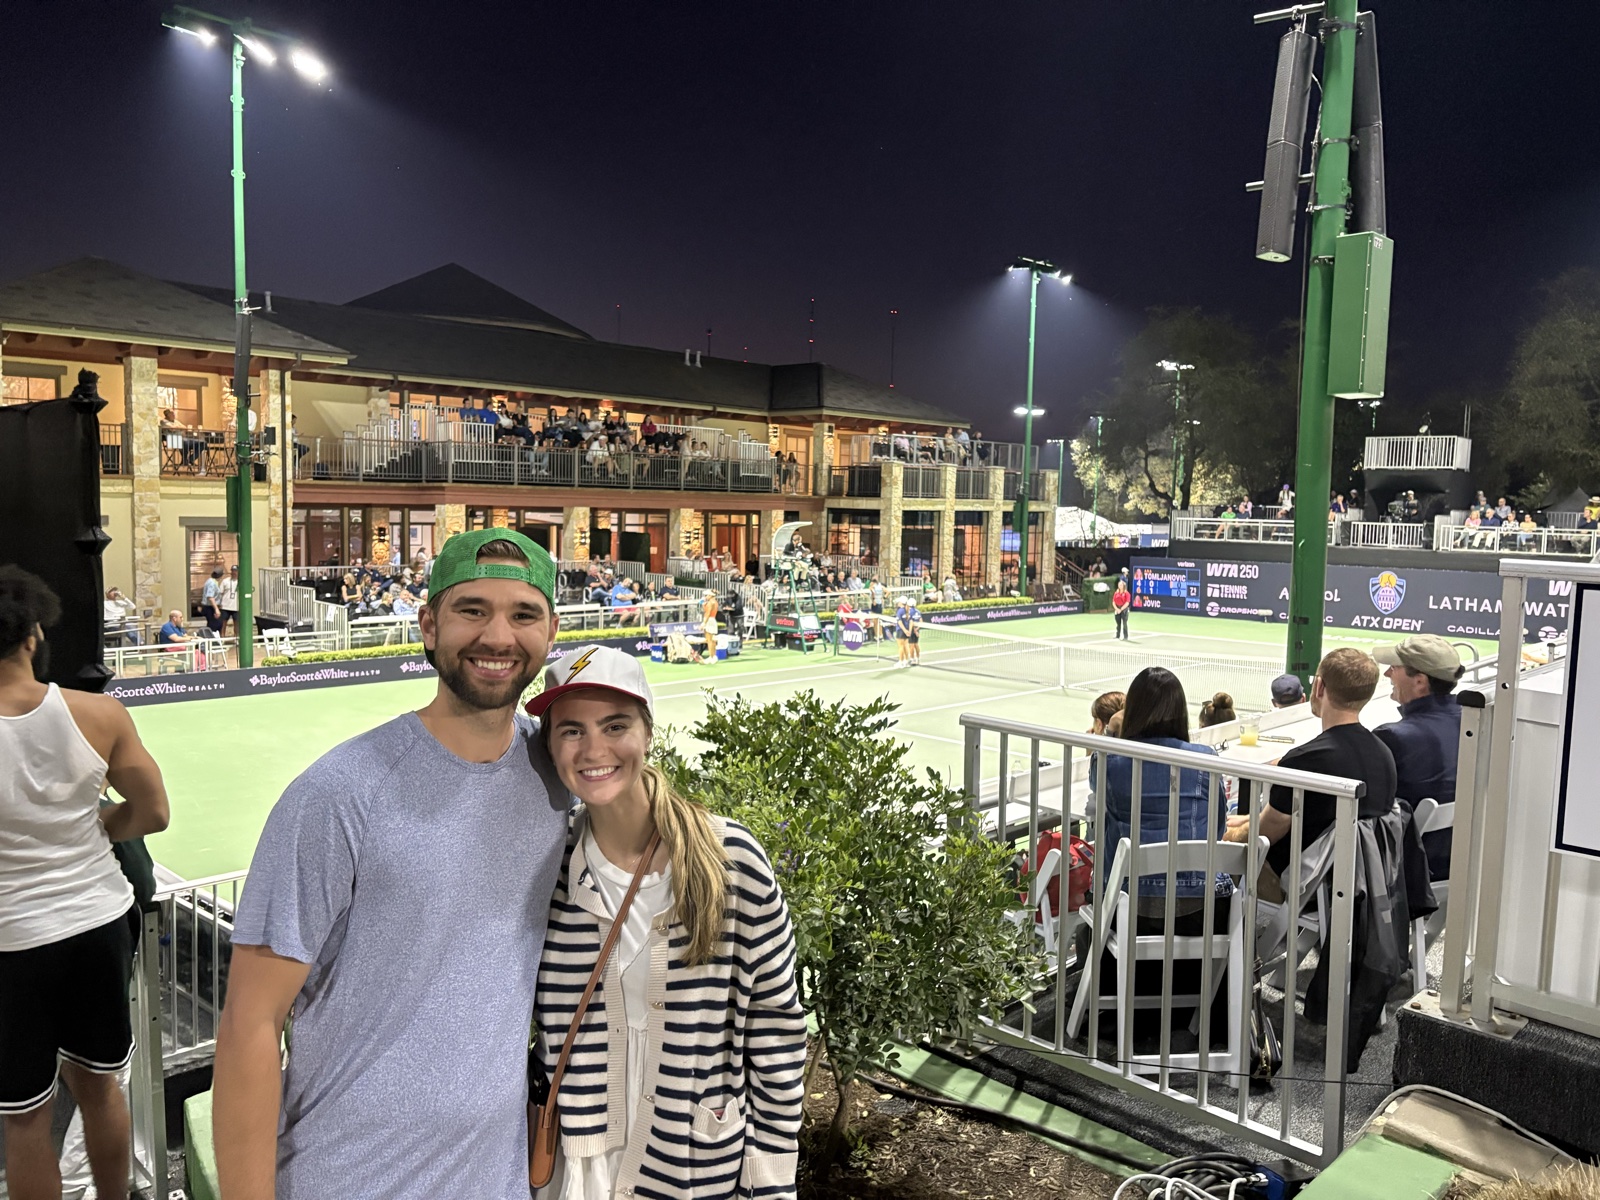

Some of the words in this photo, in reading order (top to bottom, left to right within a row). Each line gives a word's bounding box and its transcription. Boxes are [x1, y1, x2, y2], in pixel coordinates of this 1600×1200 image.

[1206, 563, 1239, 578] WTA
[1239, 564, 1259, 579] 250
[1143, 573, 1186, 583] TOMLJANOVIC
[1149, 580, 1155, 588] 0
[1220, 584, 1248, 594] TENNIS
[1143, 600, 1161, 608] JOVIC
[1220, 606, 1259, 616] DROPSHO
[1351, 615, 1381, 629] ATX
[1382, 617, 1422, 632] OPEN
[1447, 625, 1501, 637] CADILLA
[843, 631, 862, 643] WTA
[408, 660, 434, 674] Baylo
[350, 669, 381, 678] HEALTH
[188, 683, 225, 692] HEALTH
